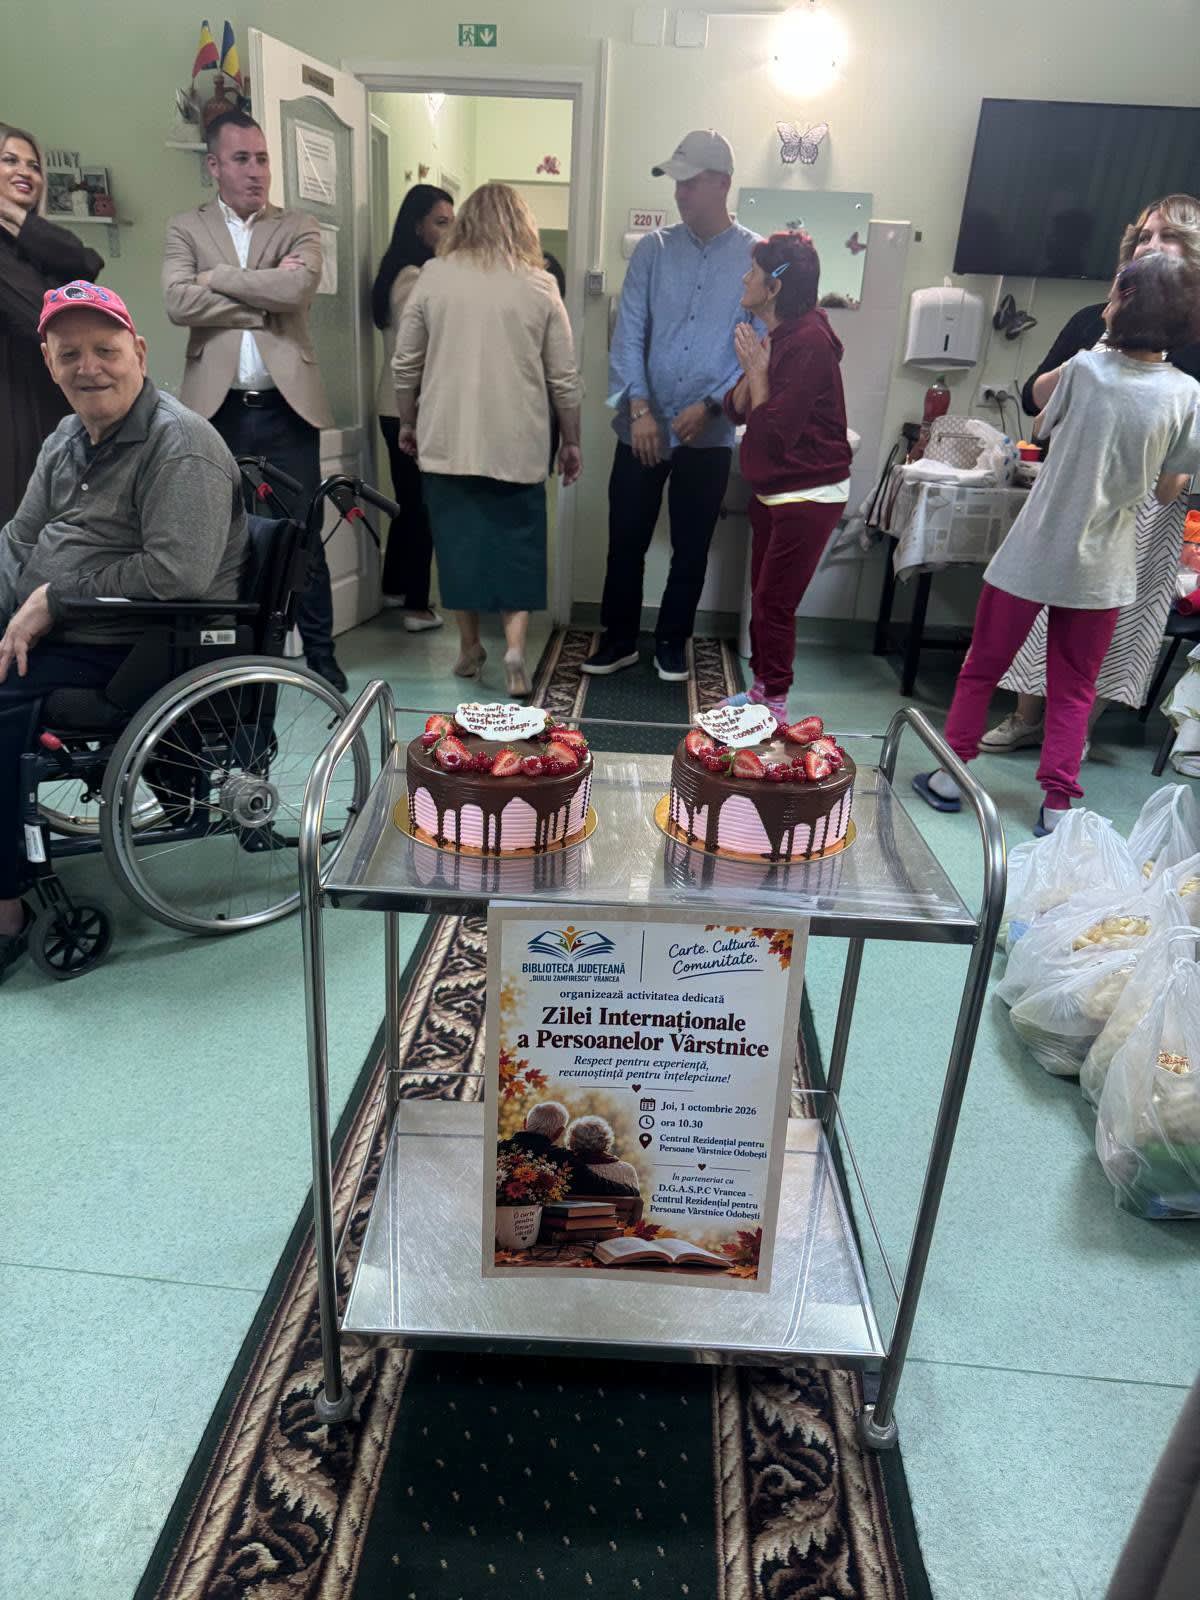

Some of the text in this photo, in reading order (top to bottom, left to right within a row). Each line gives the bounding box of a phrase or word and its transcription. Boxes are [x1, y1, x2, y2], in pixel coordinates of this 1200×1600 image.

[634, 214, 662, 227] 220 V
[668, 938, 760, 959] Carte. Cultură.
[522, 962, 626, 975] BIBLIOTECA JUDEȚEANĂ
[672, 953, 758, 975] Comunitate.
[593, 975, 620, 983] VRANCEA
[559, 989, 725, 1004] organizează activitatea dedicată
[541, 1006, 746, 1033] Zilei Internaționale
[517, 1029, 769, 1058] a Persoanelor Vârstnice
[574, 1055, 613, 1068] Respect
[615, 1057, 650, 1068] pentru
[625, 1069, 661, 1081] pentru
[660, 1101, 757, 1116] Joi, 1 octombrie 2026
[678, 1119, 704, 1129] 10.30
[659, 1133, 691, 1143] Centrul
[737, 1140, 765, 1149] pentru
[659, 1144, 695, 1154] Persoane
[681, 1174, 724, 1185] parteneriat
[713, 1187, 747, 1198] Vrancea
[651, 1194, 683, 1204] Centrul
[731, 1201, 758, 1210] pentru
[649, 1204, 686, 1215] Persoane
